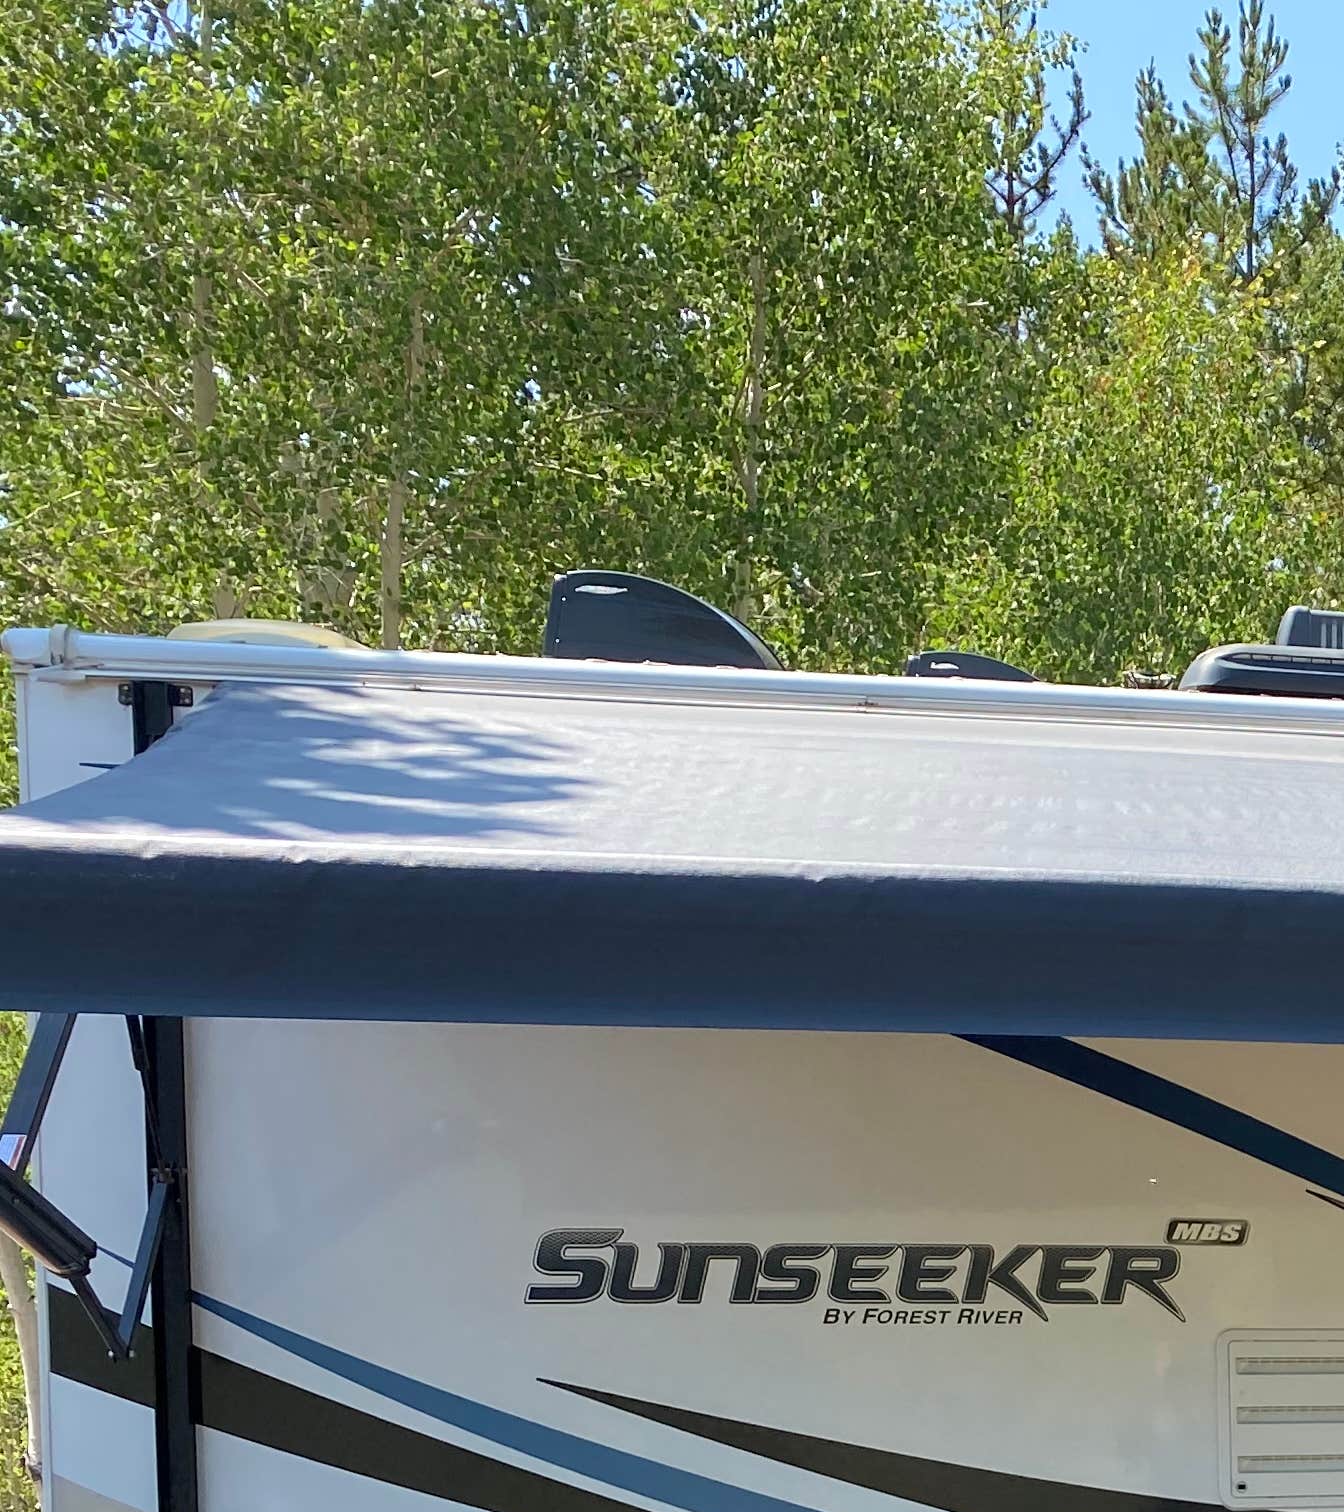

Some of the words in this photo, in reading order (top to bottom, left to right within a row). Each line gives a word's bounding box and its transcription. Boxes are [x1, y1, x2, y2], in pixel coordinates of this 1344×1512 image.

[1171, 1222, 1242, 1242] MBS
[823, 1308, 855, 1325] BY
[862, 1308, 951, 1325] FOREST
[957, 1308, 1023, 1325] RIVER
